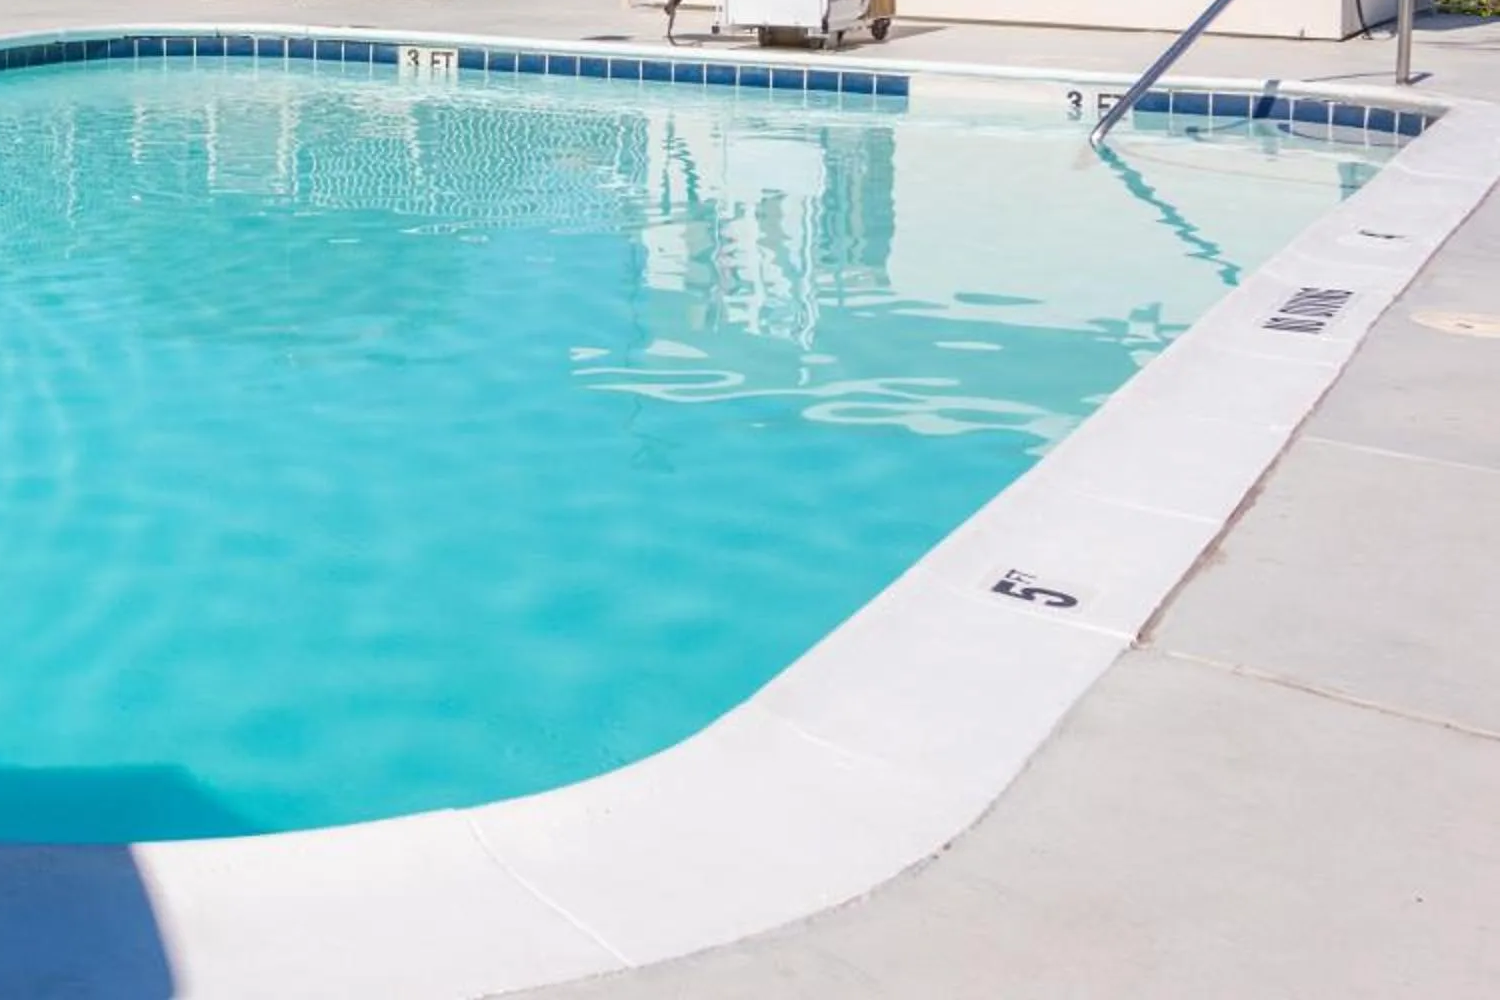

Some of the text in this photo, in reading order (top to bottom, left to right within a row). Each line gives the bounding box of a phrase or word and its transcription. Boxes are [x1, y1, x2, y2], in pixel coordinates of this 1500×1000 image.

[406, 48, 455, 69] 3 FT
[1066, 90, 1083, 113] 3
[991, 568, 1079, 608] 5 FT
